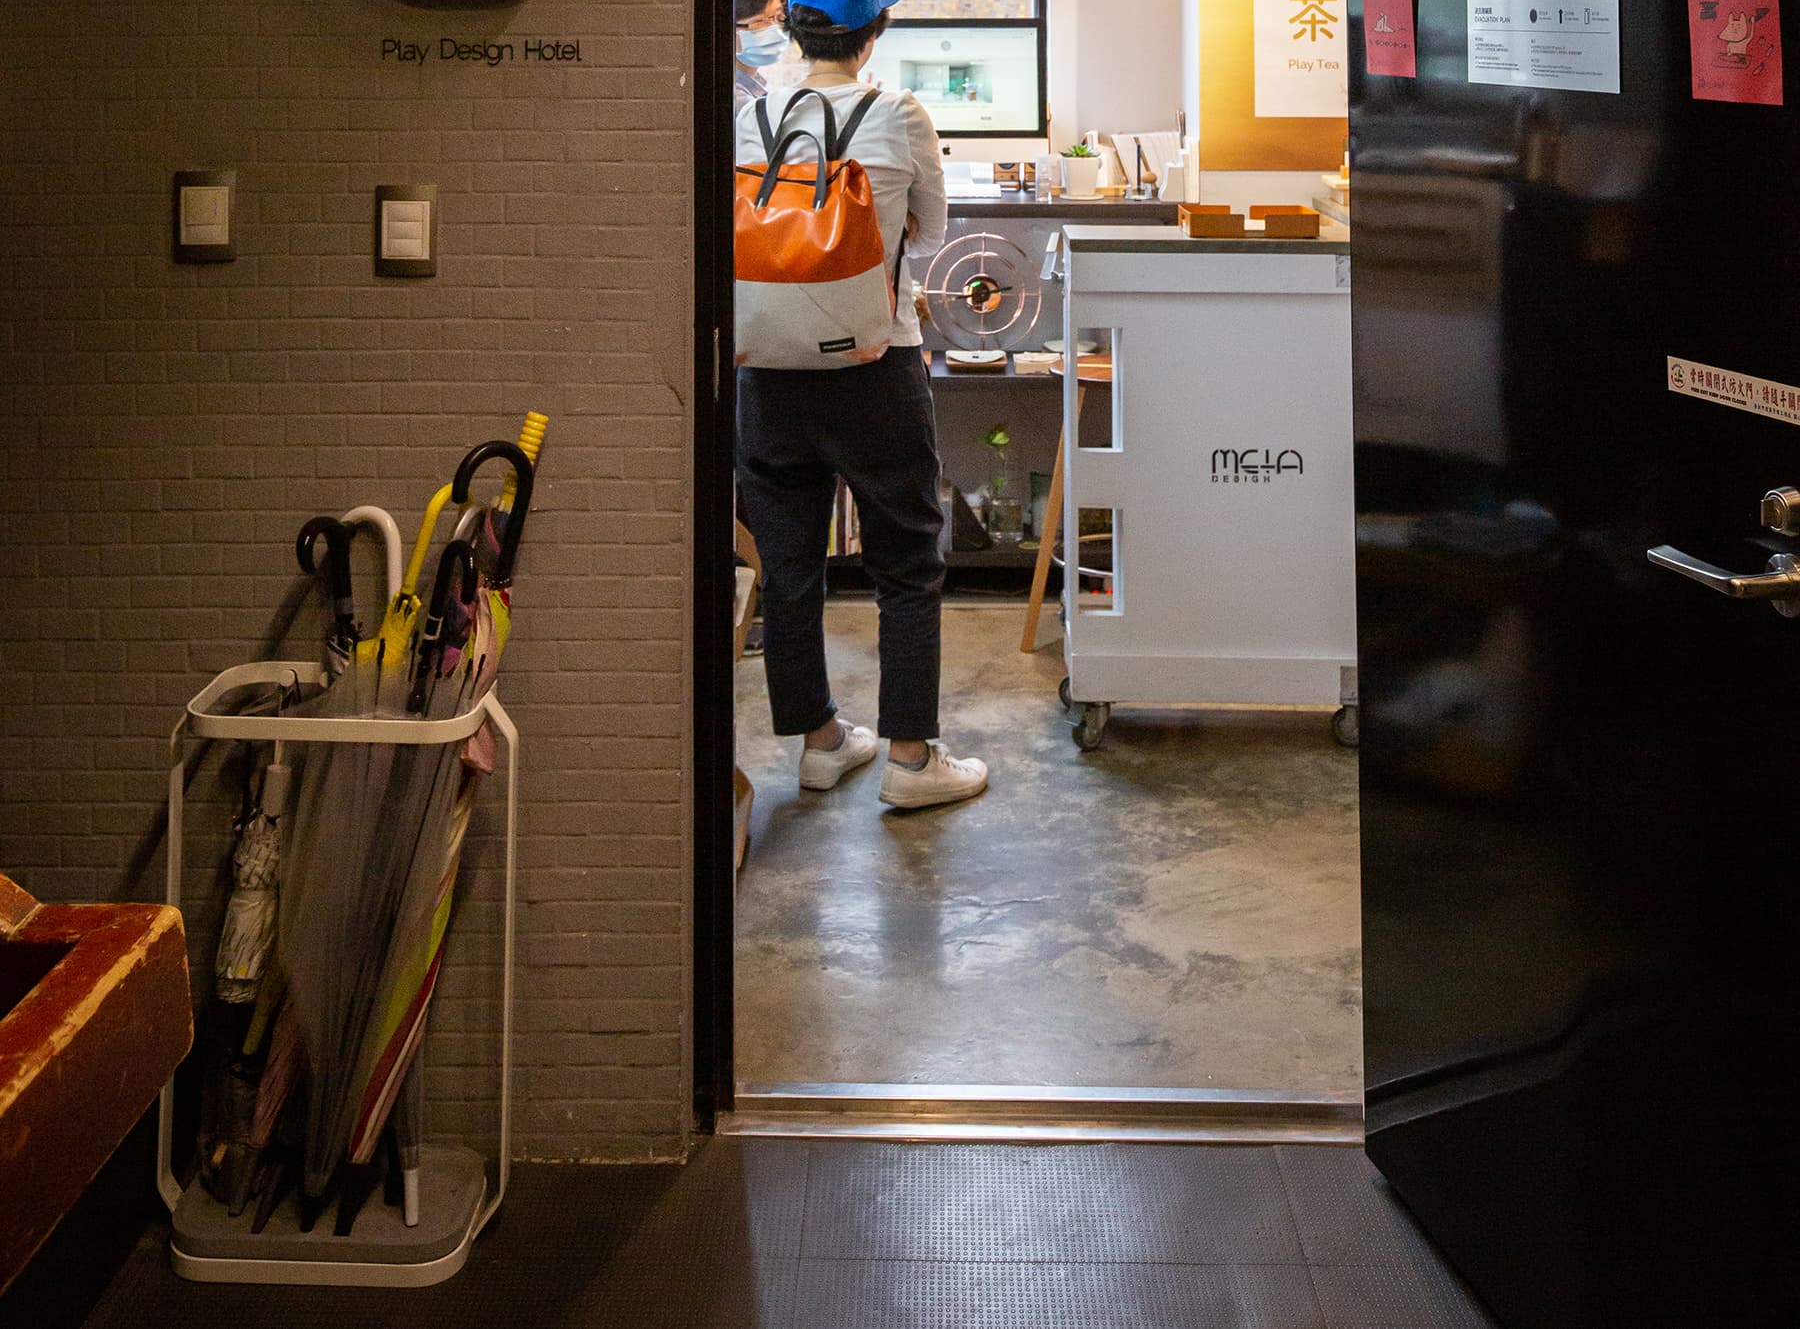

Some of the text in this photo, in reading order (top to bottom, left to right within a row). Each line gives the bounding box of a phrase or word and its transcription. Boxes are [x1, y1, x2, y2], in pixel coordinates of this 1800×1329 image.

[382, 39, 582, 65] Play Design Hotel
[1288, 58, 1340, 72] Play Tea
[1211, 475, 1271, 483] DESIGN
